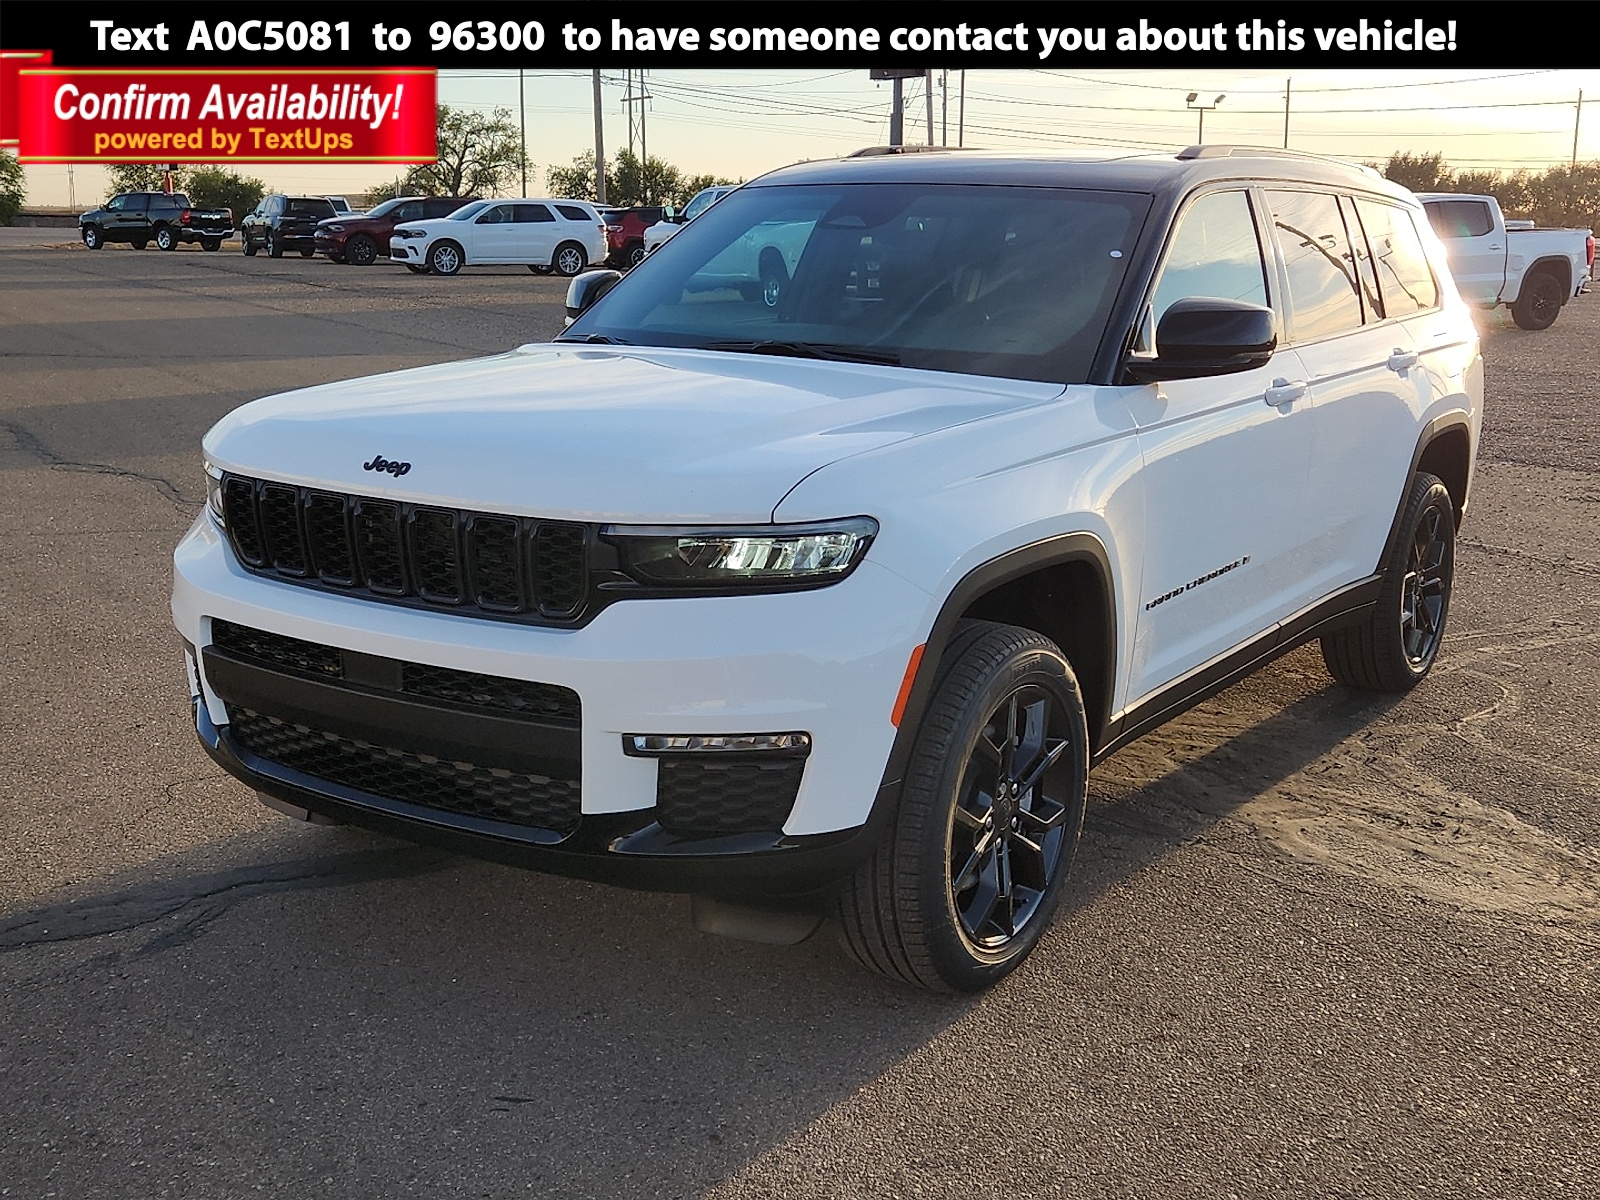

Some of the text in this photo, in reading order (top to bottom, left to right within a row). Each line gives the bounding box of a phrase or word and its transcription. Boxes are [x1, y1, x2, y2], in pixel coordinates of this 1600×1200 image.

[363, 455, 412, 478] Jeep
[1145, 587, 1184, 611] GRAND
[1185, 560, 1241, 591] CHEROKEE
